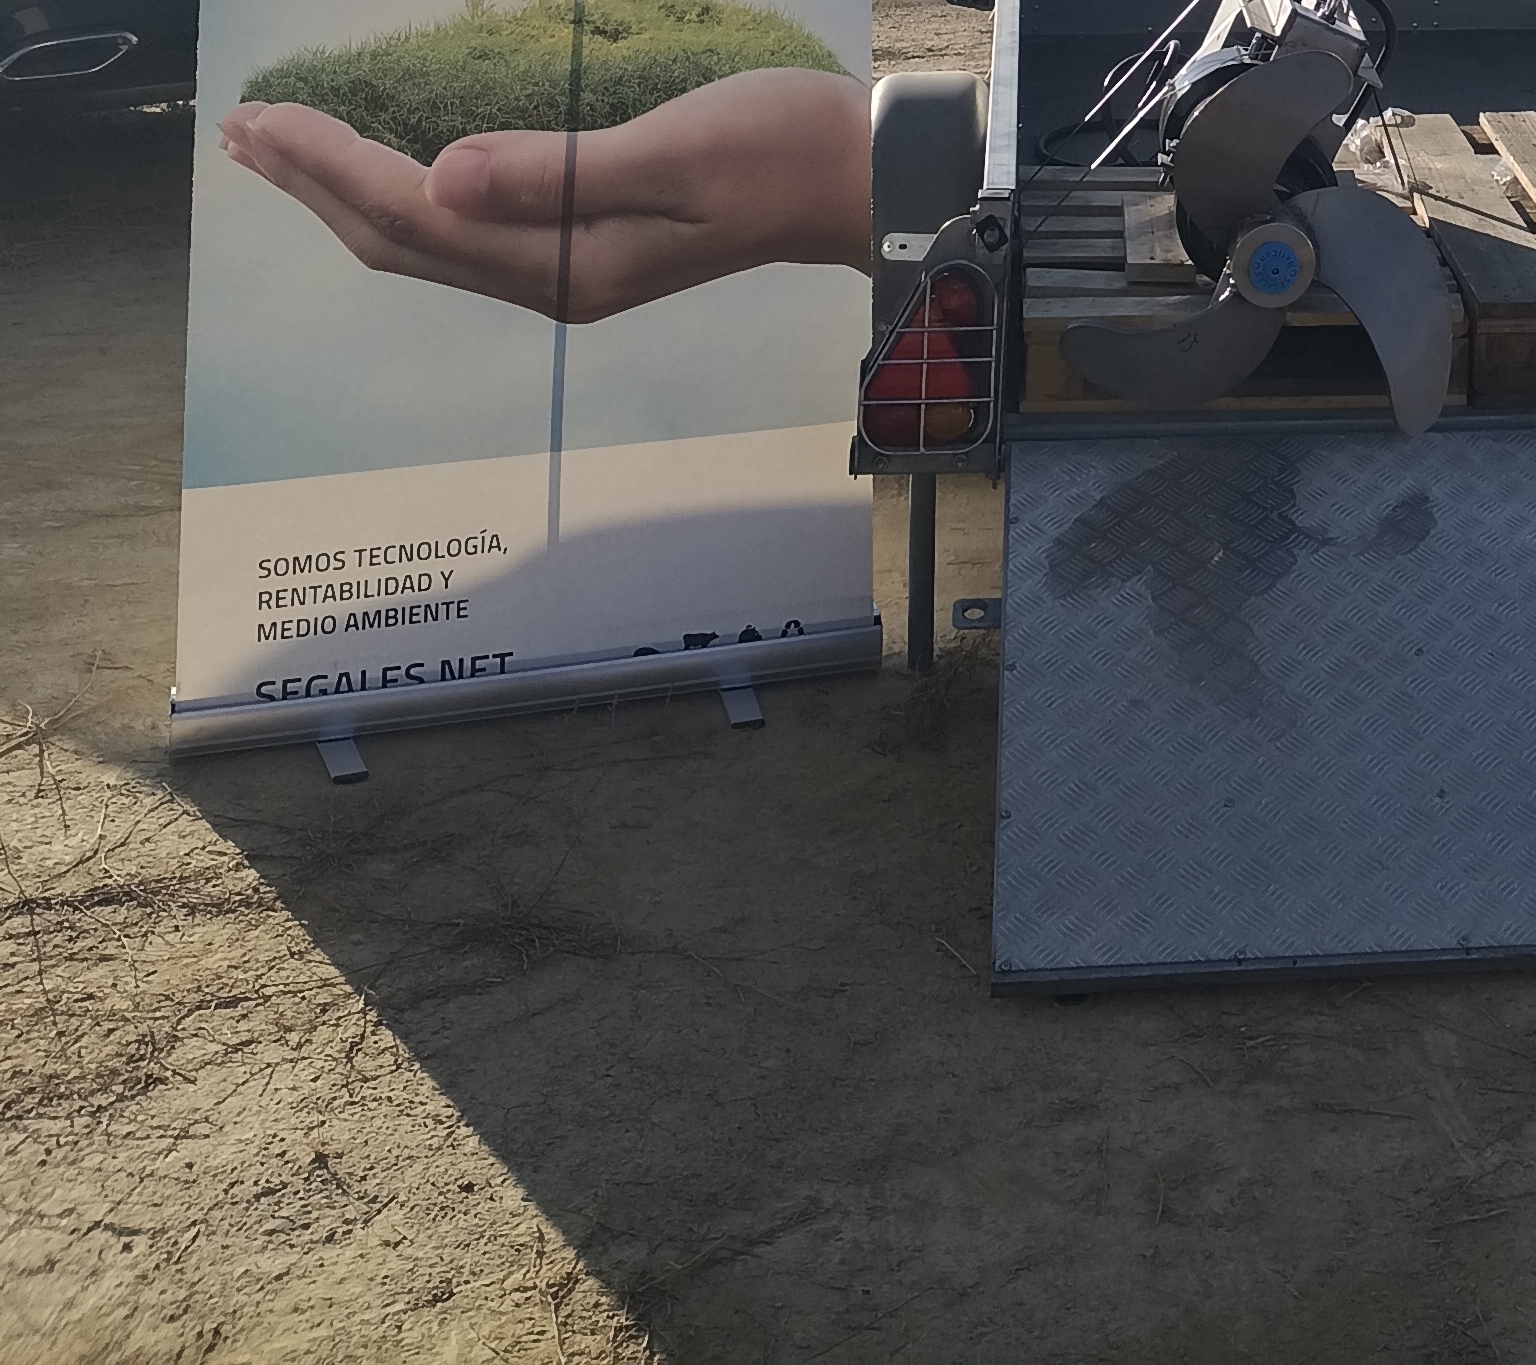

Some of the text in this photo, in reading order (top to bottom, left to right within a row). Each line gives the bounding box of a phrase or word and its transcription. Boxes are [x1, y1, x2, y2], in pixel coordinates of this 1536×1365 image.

[258, 528, 508, 579] SOMOS TECNOLOGÍA,
[258, 569, 455, 611] RENTABILIDAD Y
[257, 599, 470, 643] MEDIO AMBIENTE
